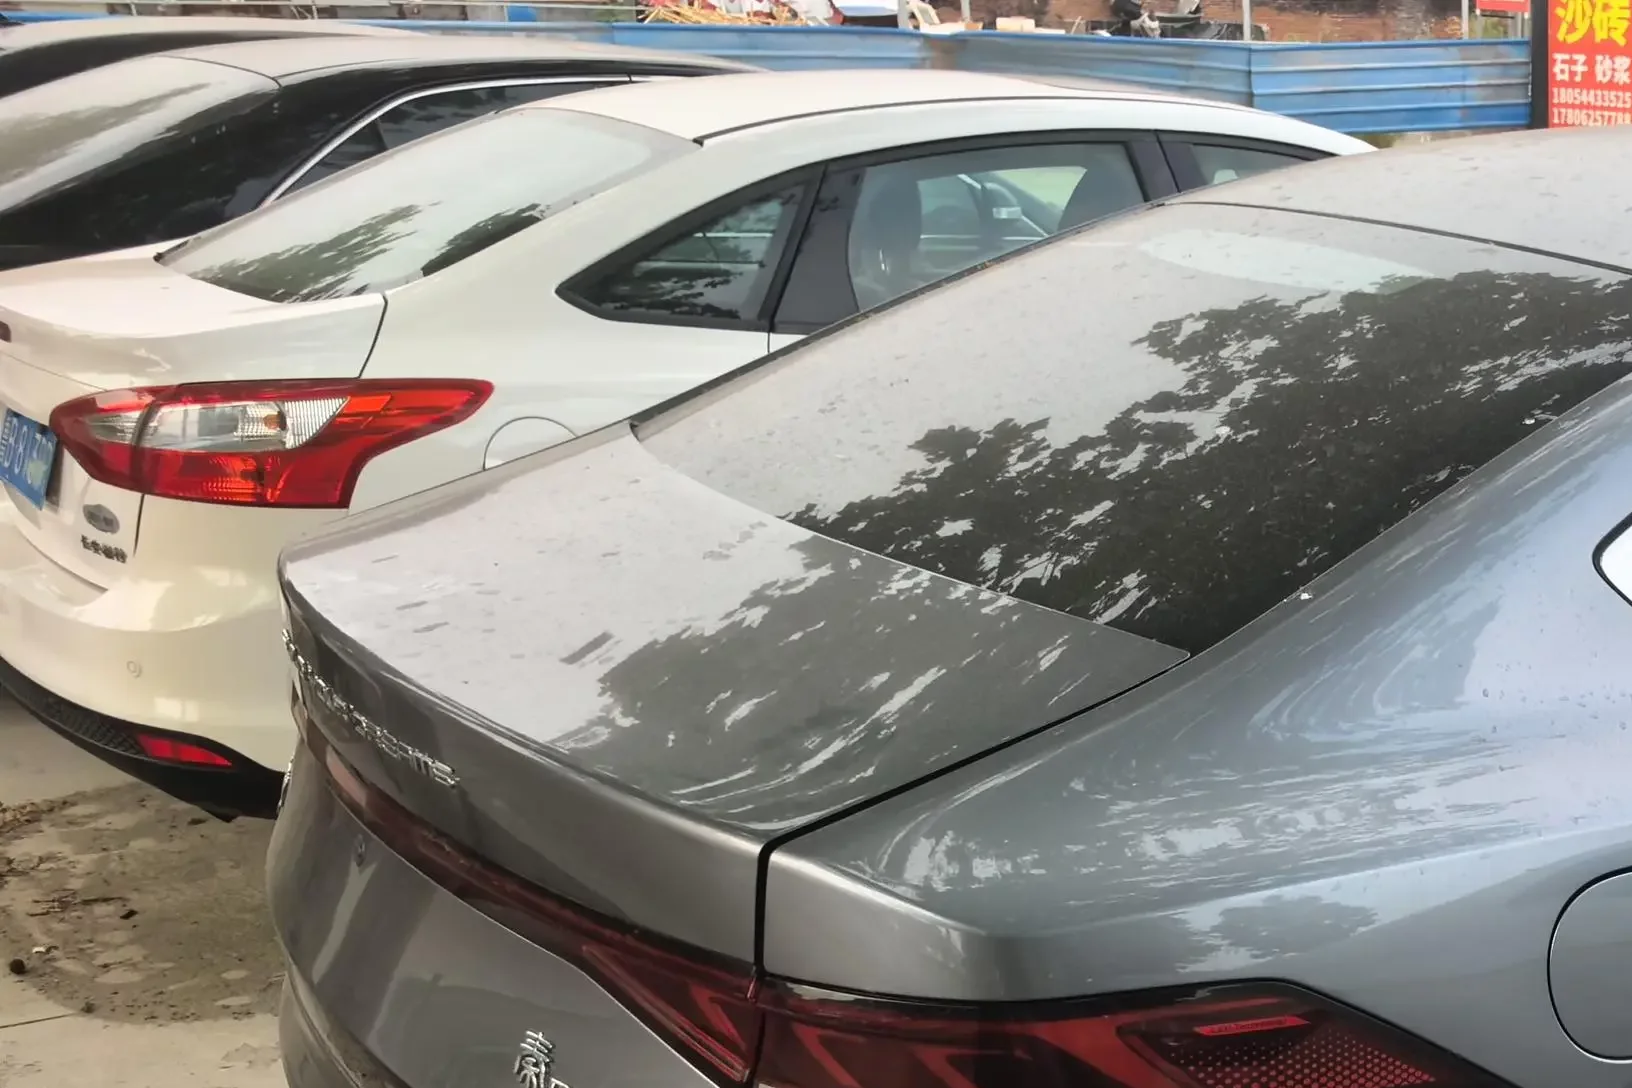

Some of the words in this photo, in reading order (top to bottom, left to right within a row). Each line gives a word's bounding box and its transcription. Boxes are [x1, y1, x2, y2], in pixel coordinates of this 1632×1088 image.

[1555, 0, 1631, 46] 沙砖
[1552, 53, 1588, 82] 石子
[1595, 54, 1631, 85] 砂浆
